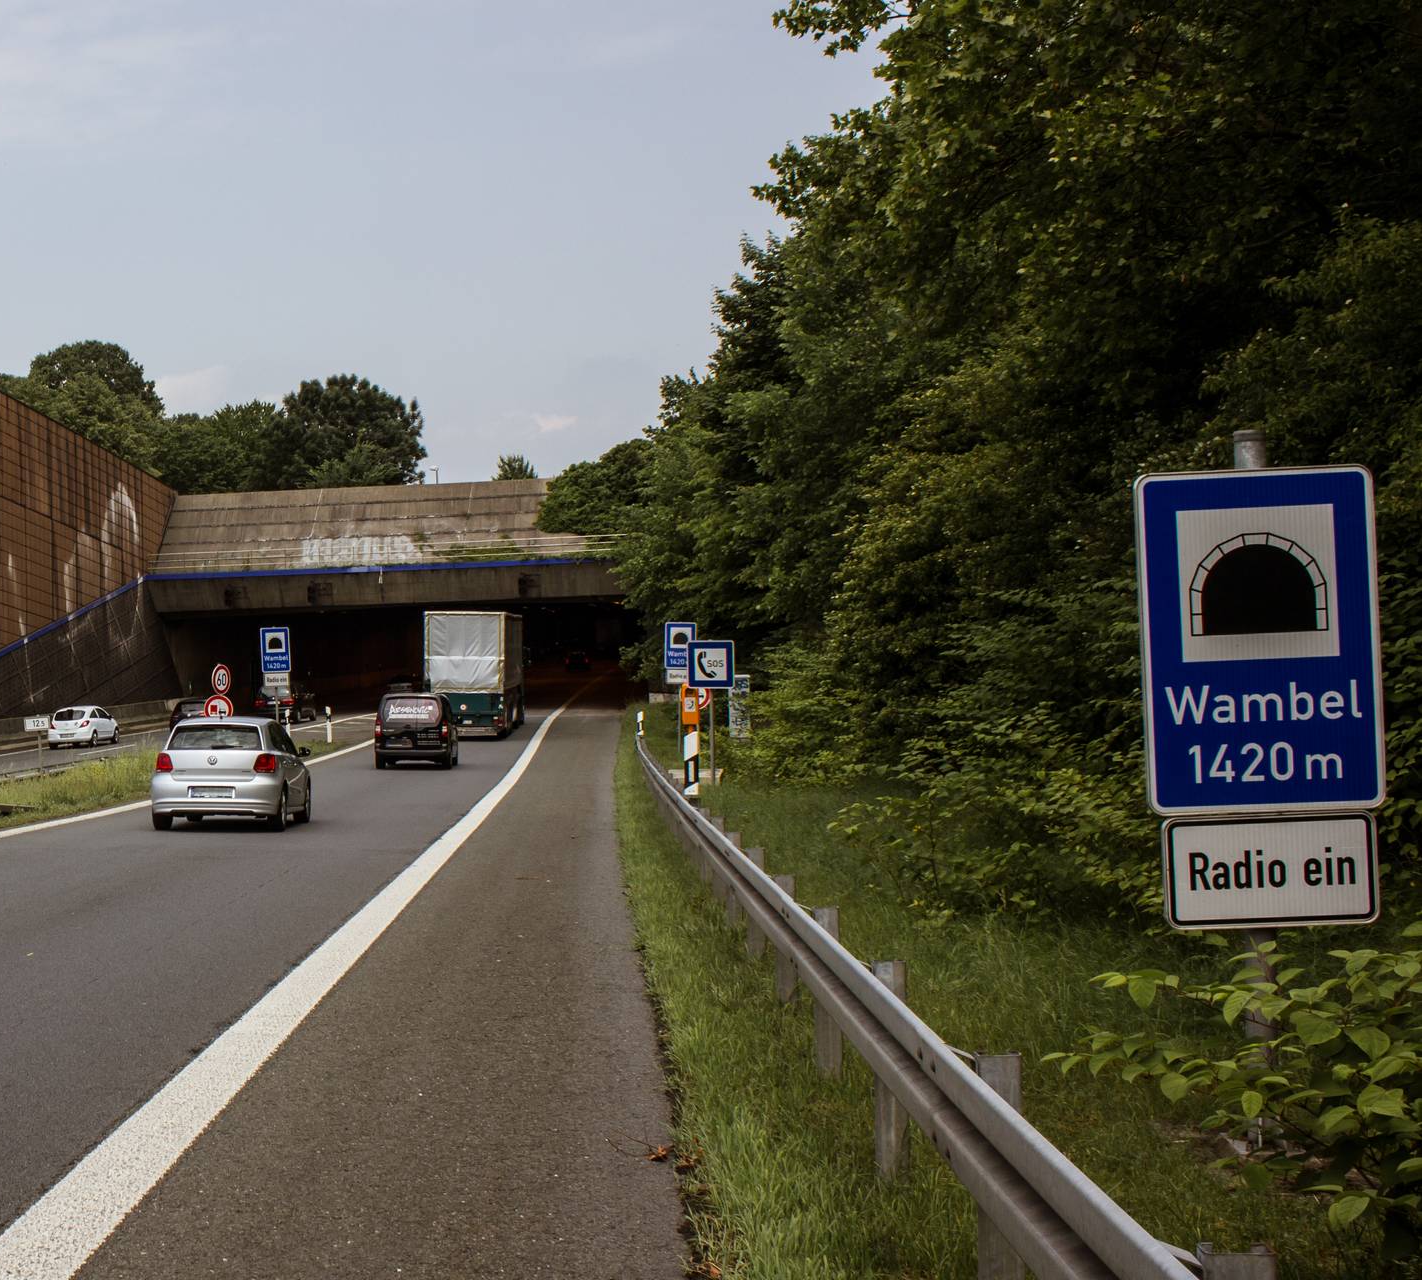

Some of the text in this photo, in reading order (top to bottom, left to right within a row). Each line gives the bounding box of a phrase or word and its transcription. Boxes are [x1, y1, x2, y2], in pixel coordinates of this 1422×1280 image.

[217, 673, 226, 686] 60
[1164, 679, 1363, 725] Wambel
[1188, 741, 1343, 784] 1420 m
[1188, 847, 1357, 891] Radio ein
